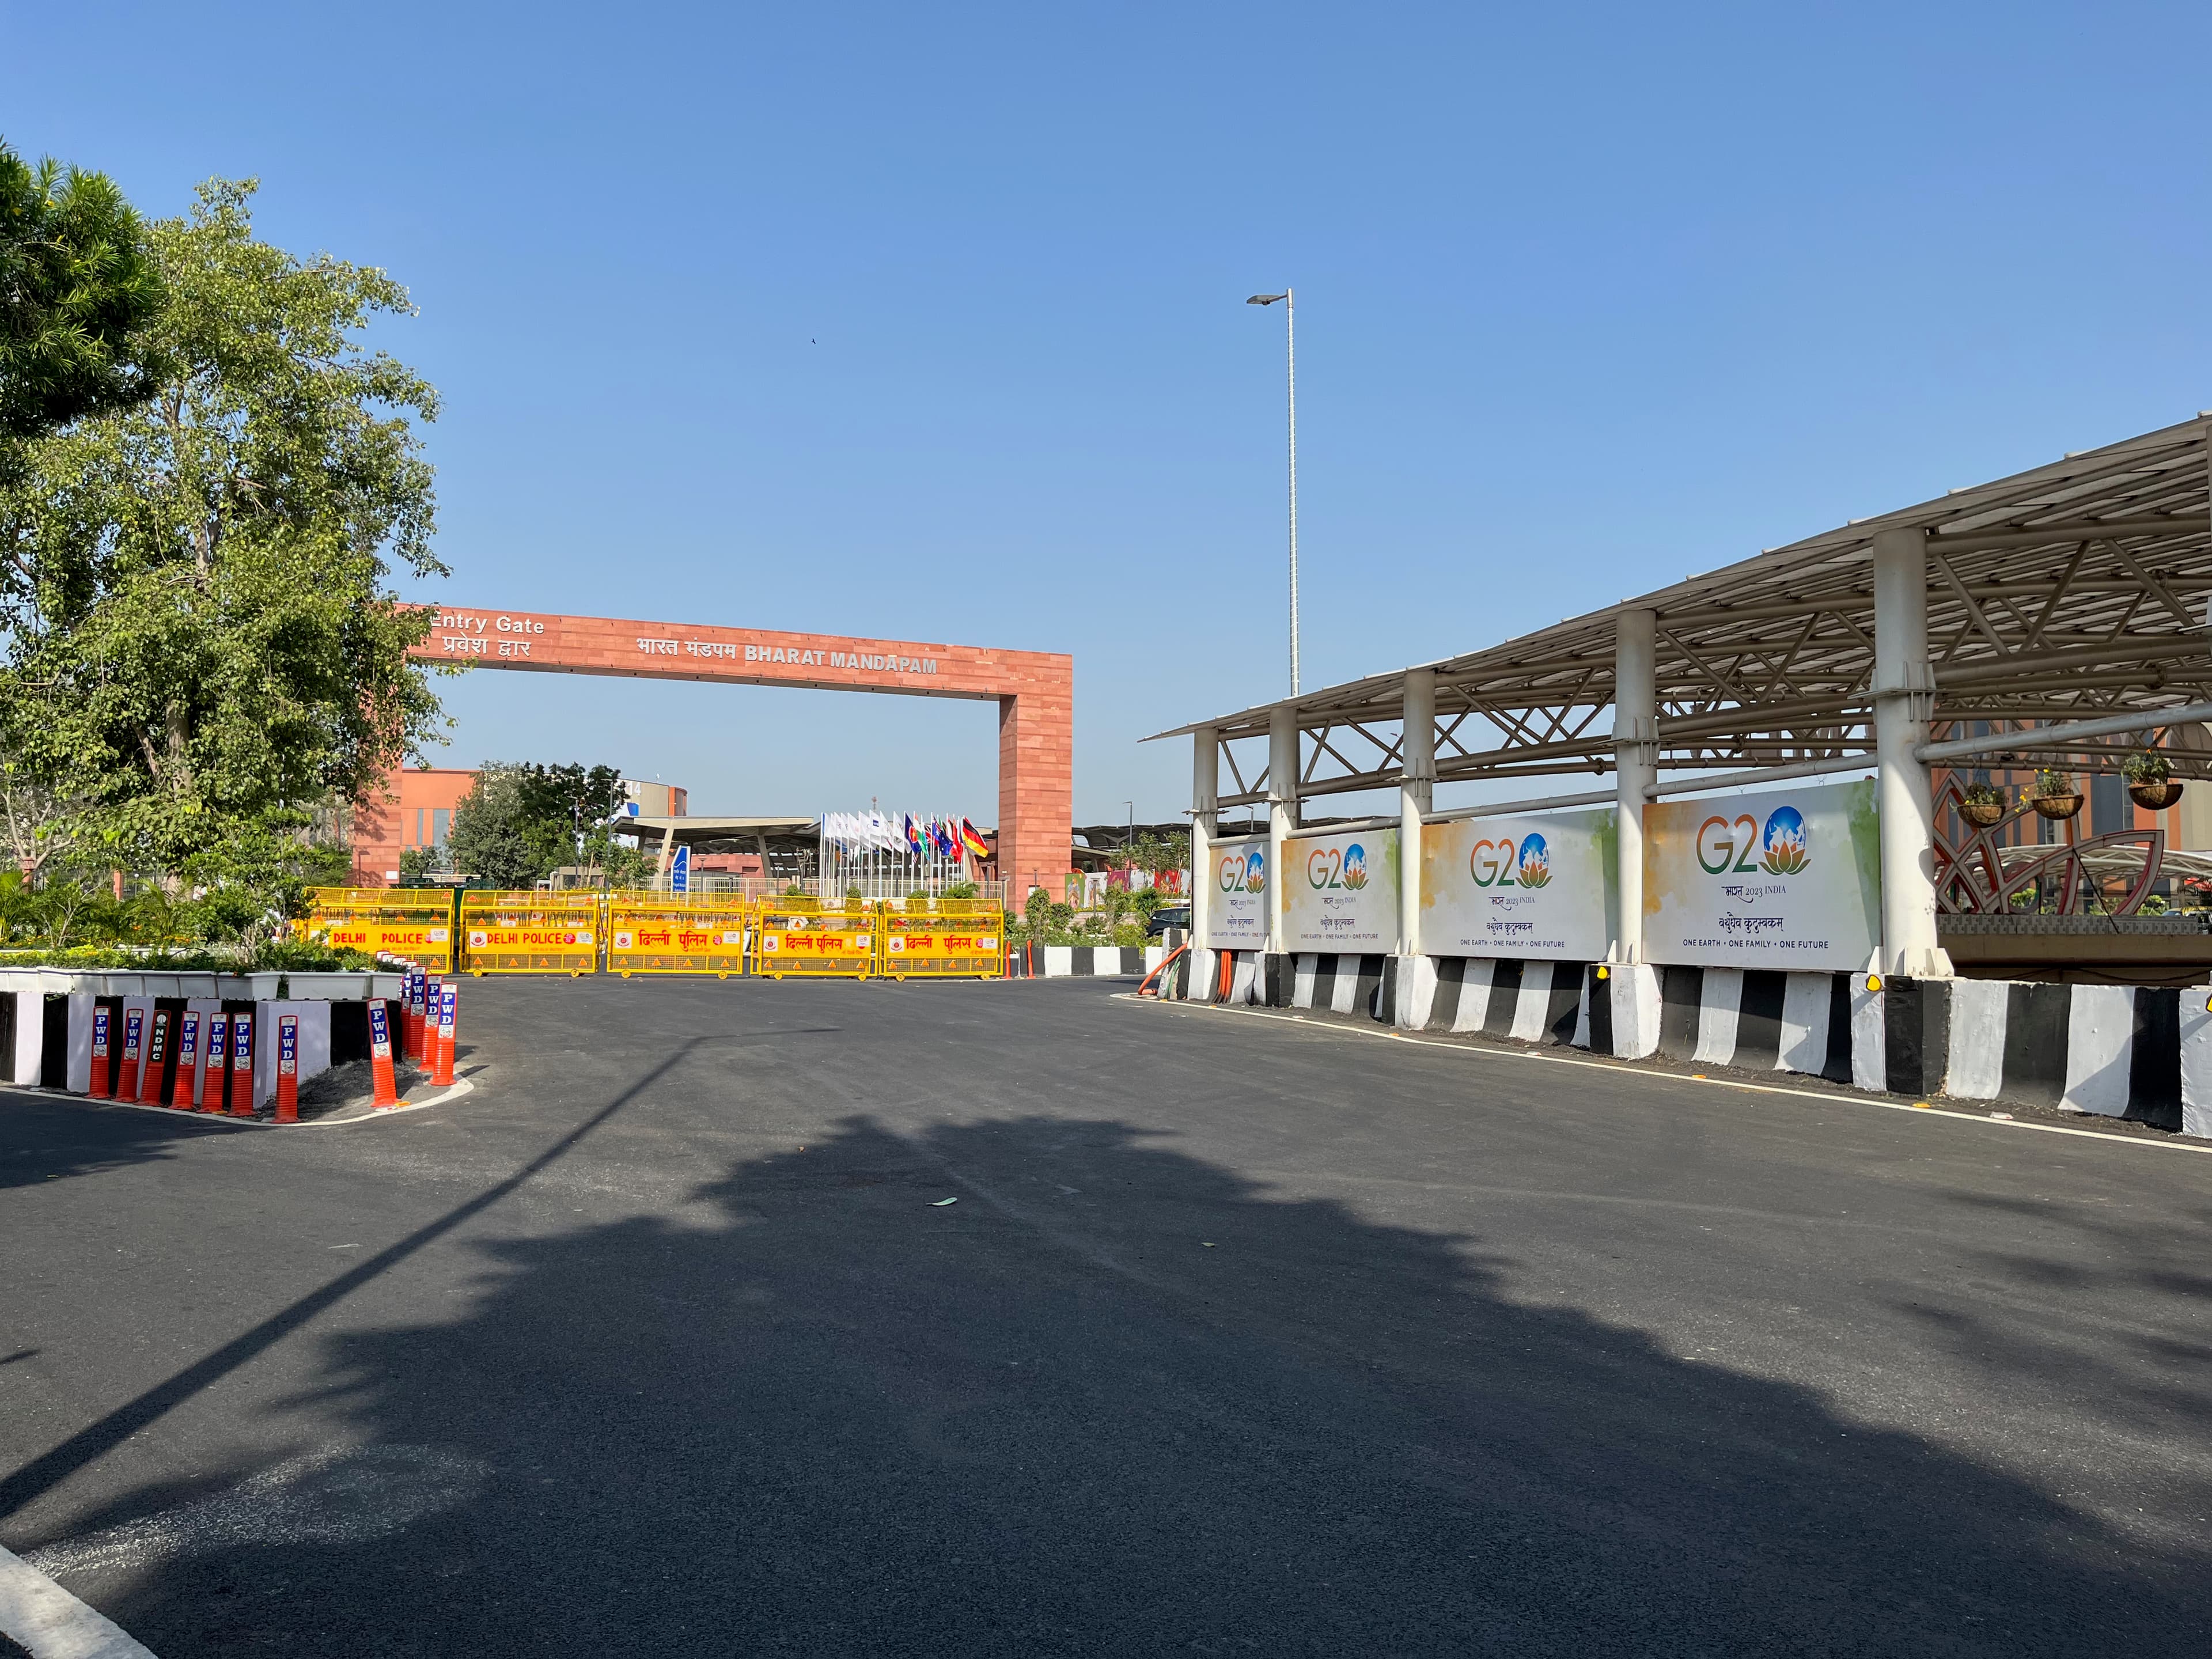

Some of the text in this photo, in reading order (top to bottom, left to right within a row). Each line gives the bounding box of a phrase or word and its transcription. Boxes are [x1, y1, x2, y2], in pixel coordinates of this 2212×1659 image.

[430, 611, 544, 634] Entry Gate
[442, 631, 531, 657] प्रवेश द्वार
[637, 637, 737, 659] भारत मंडपम
[745, 645, 937, 674] BHARAT MANDAPAM
[1696, 805, 1812, 875] G20
[1219, 852, 1266, 894] G20
[1308, 843, 1369, 891] G20
[1470, 833, 1553, 888] G20
[1745, 888, 1763, 897] 2023
[1764, 885, 1786, 894] INDIA
[334, 933, 366, 943] DELHI
[382, 933, 423, 944] POLICE
[487, 933, 518, 944] DELHI
[523, 933, 562, 944] POLICE
[638, 929, 671, 948] दिल्ली
[678, 930, 708, 952] पुलिस
[785, 933, 813, 952] दिल्ली
[816, 934, 843, 953] पुलिस
[905, 934, 933, 950] दिल्ली
[943, 934, 971, 954] पुलिस
[1779, 940, 1795, 948] ONE
[1798, 941, 1829, 949] FUTURE
[413, 976, 423, 1003] PWD
[428, 985, 439, 1014] PWD
[441, 994, 453, 1024] PWD
[96, 1017, 107, 1044] PWD
[128, 1019, 139, 1047] PWD
[183, 1022, 195, 1051] PWD
[211, 1024, 224, 1054] PWD
[236, 1024, 249, 1056] PWD
[373, 1010, 386, 1043] PWD
[153, 1029, 164, 1059] NDMC
[282, 1027, 294, 1059] PWD
